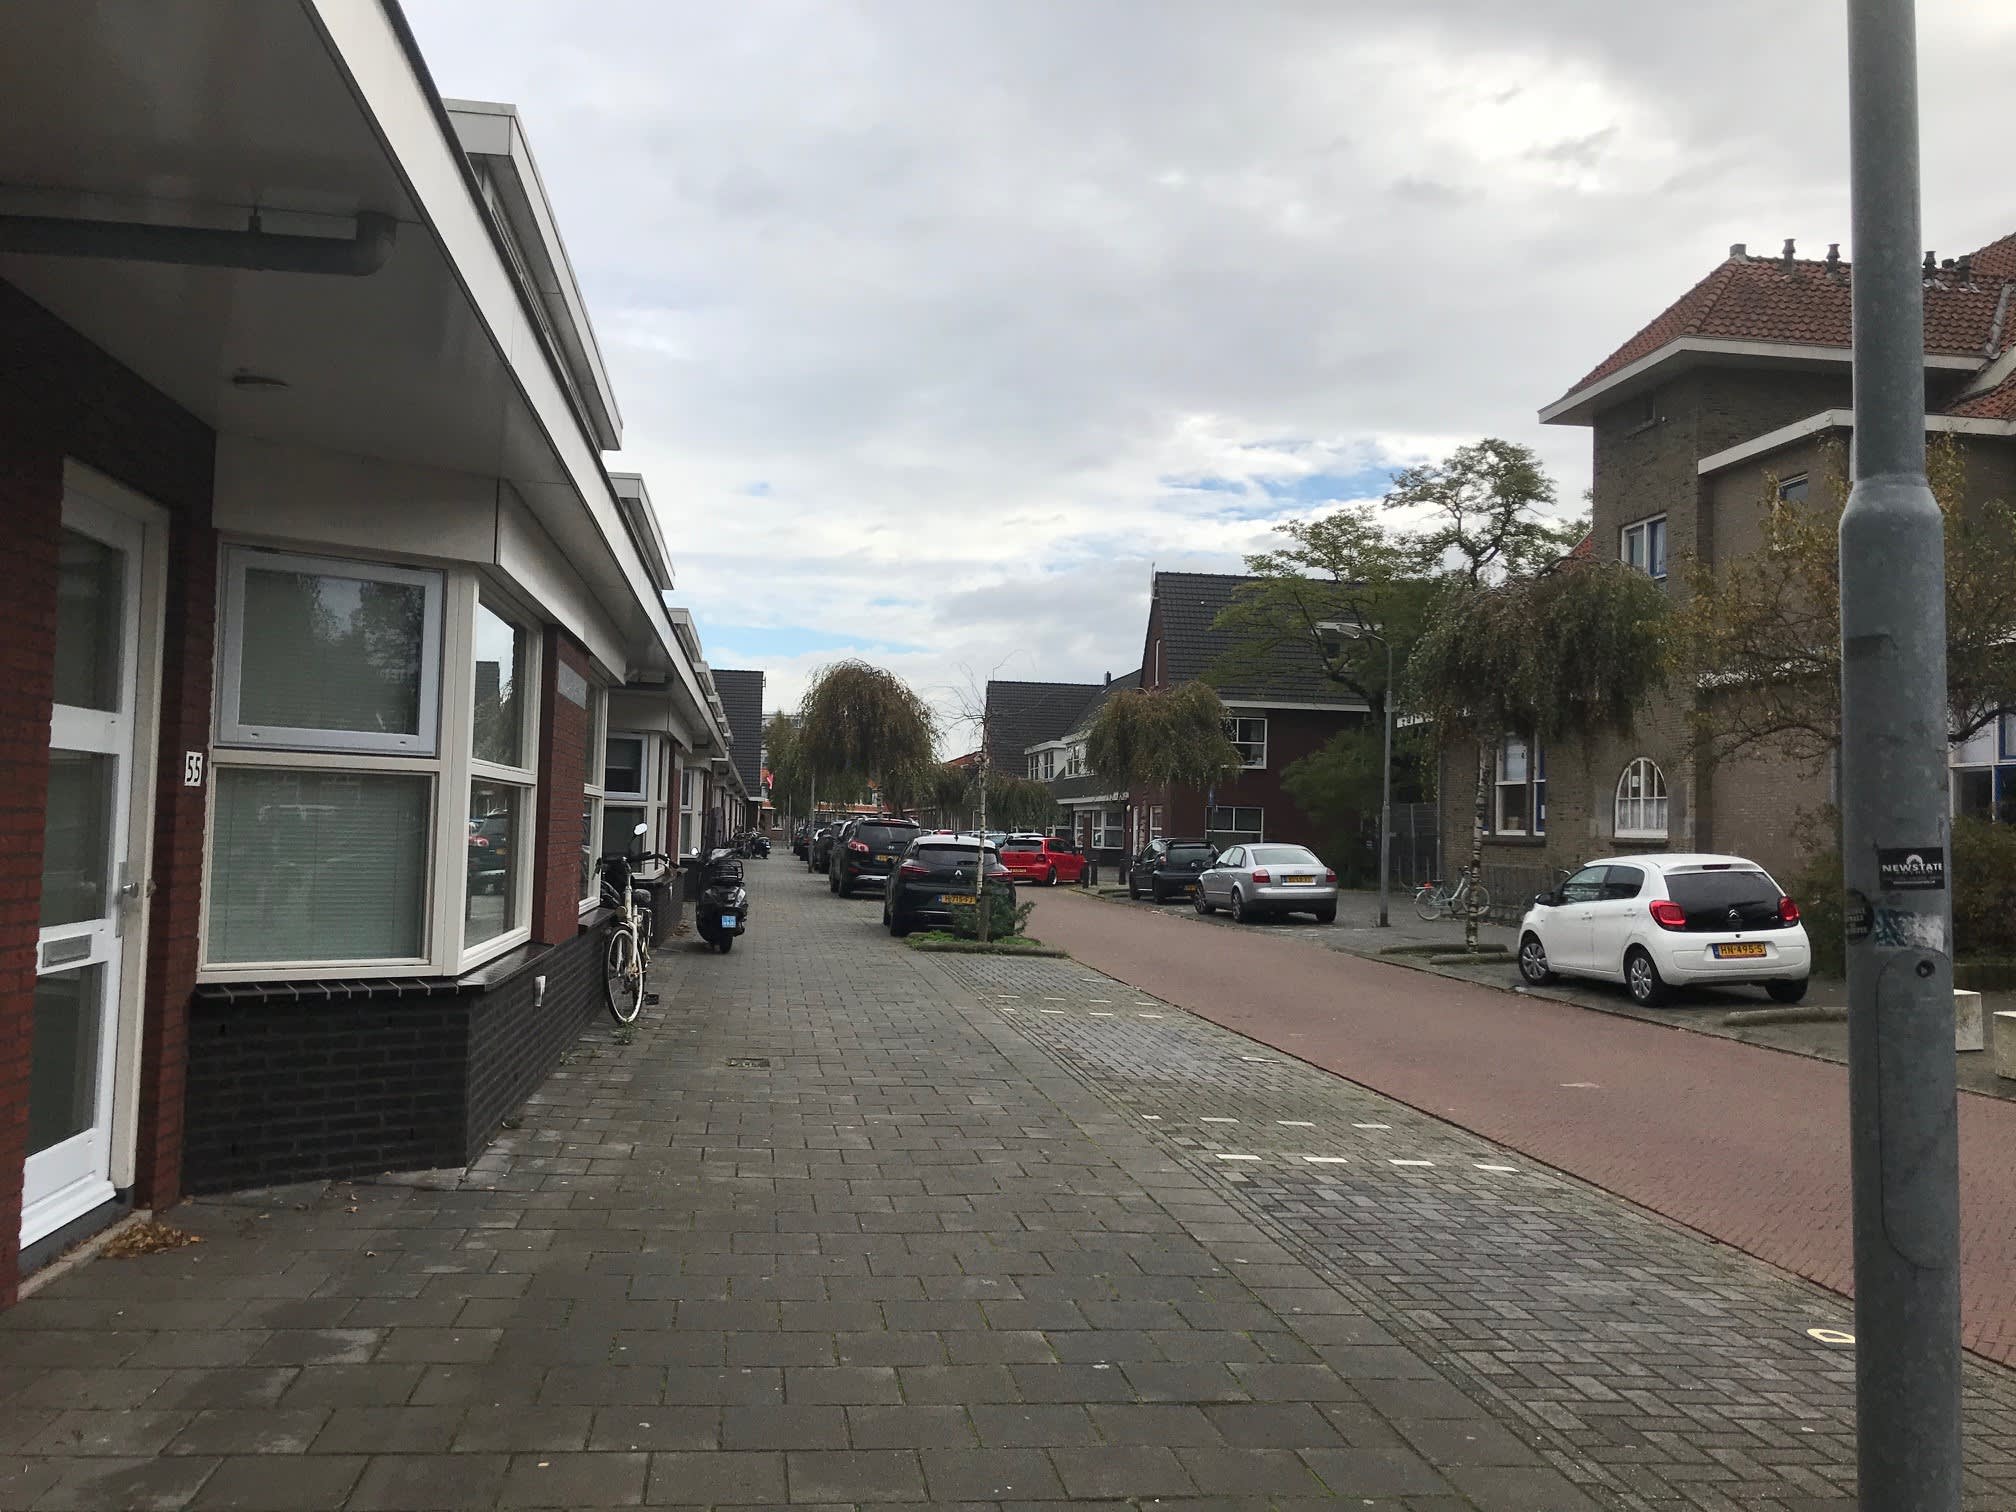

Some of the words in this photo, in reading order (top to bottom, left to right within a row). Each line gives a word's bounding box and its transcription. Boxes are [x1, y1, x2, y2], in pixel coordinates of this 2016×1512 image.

[186, 755, 201, 783] 55
[1881, 863, 1943, 872] NEWSTATE
[1720, 944, 1763, 955] HN-495-S
